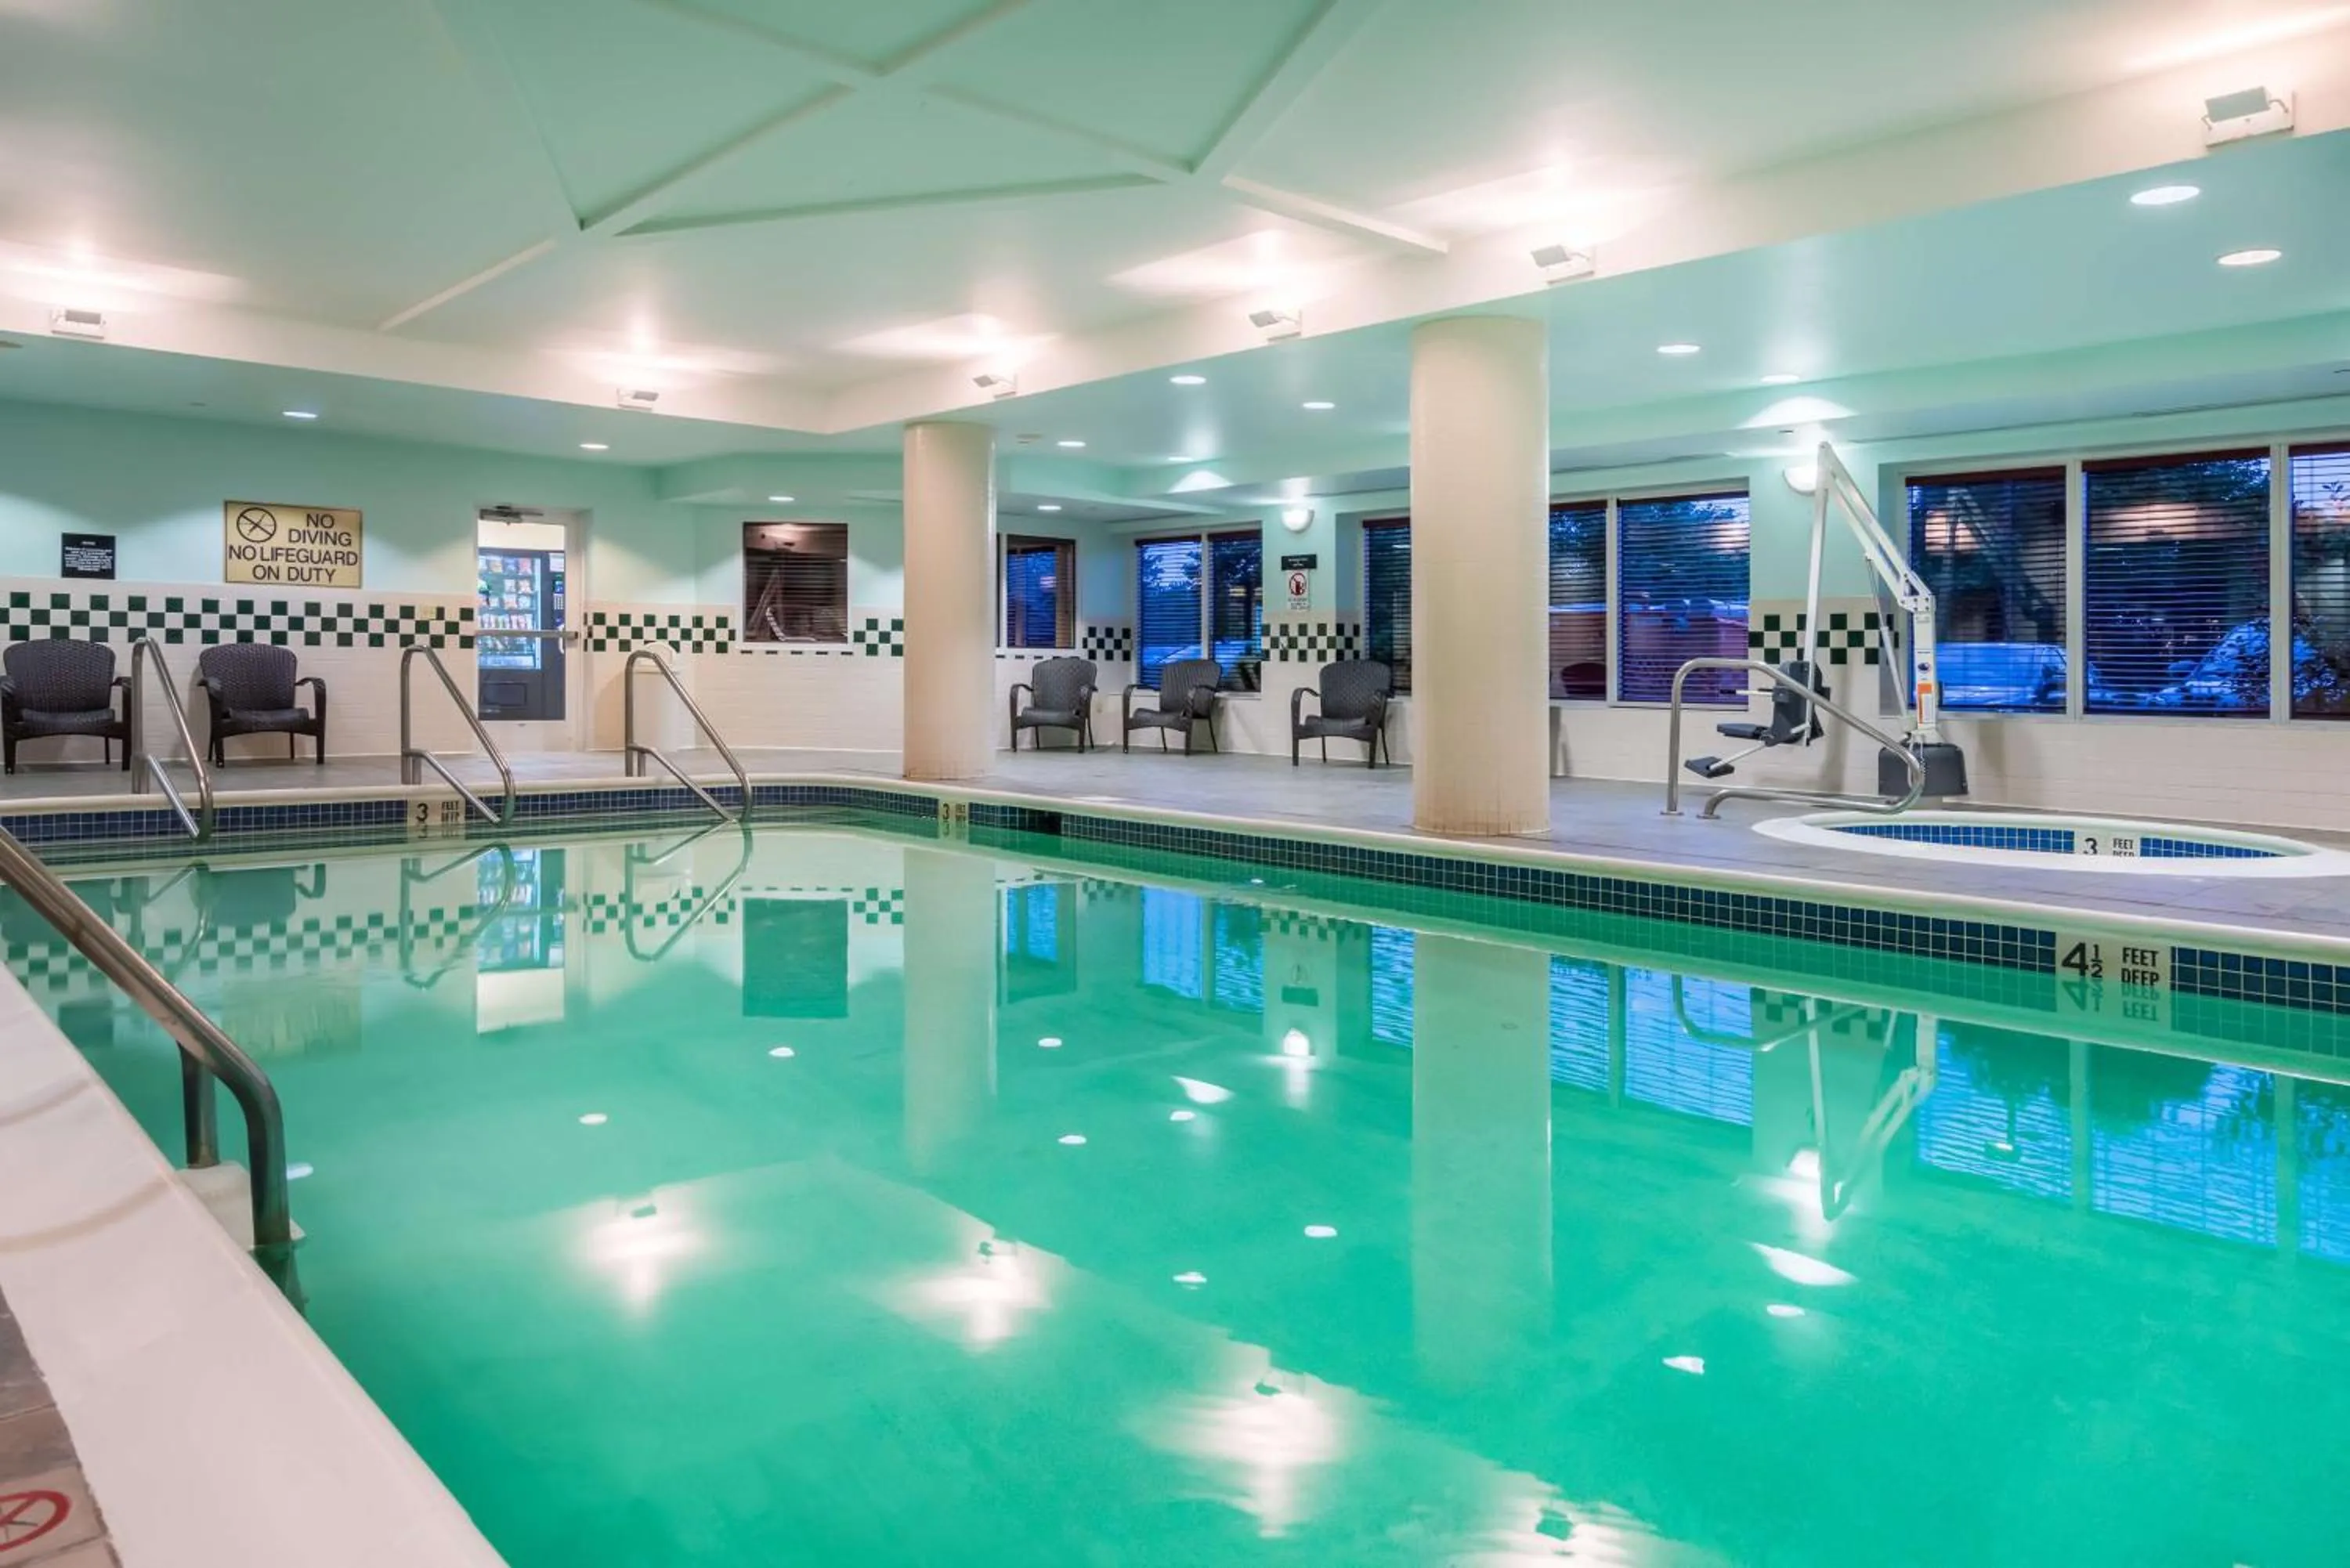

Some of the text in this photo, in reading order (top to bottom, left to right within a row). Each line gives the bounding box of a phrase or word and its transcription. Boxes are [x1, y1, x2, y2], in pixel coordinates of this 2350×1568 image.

[306, 513, 334, 529] NO
[288, 529, 352, 547] DIVING
[228, 544, 359, 566] NO LIFEGUARD
[252, 565, 337, 583] ON DUTY
[416, 803, 428, 822] 3
[942, 803, 950, 820] 3
[2083, 837, 2098, 855] 3
[2113, 838, 2135, 850] FEET
[2122, 947, 2160, 967] FEET
[2121, 968, 2160, 986] DEEP
